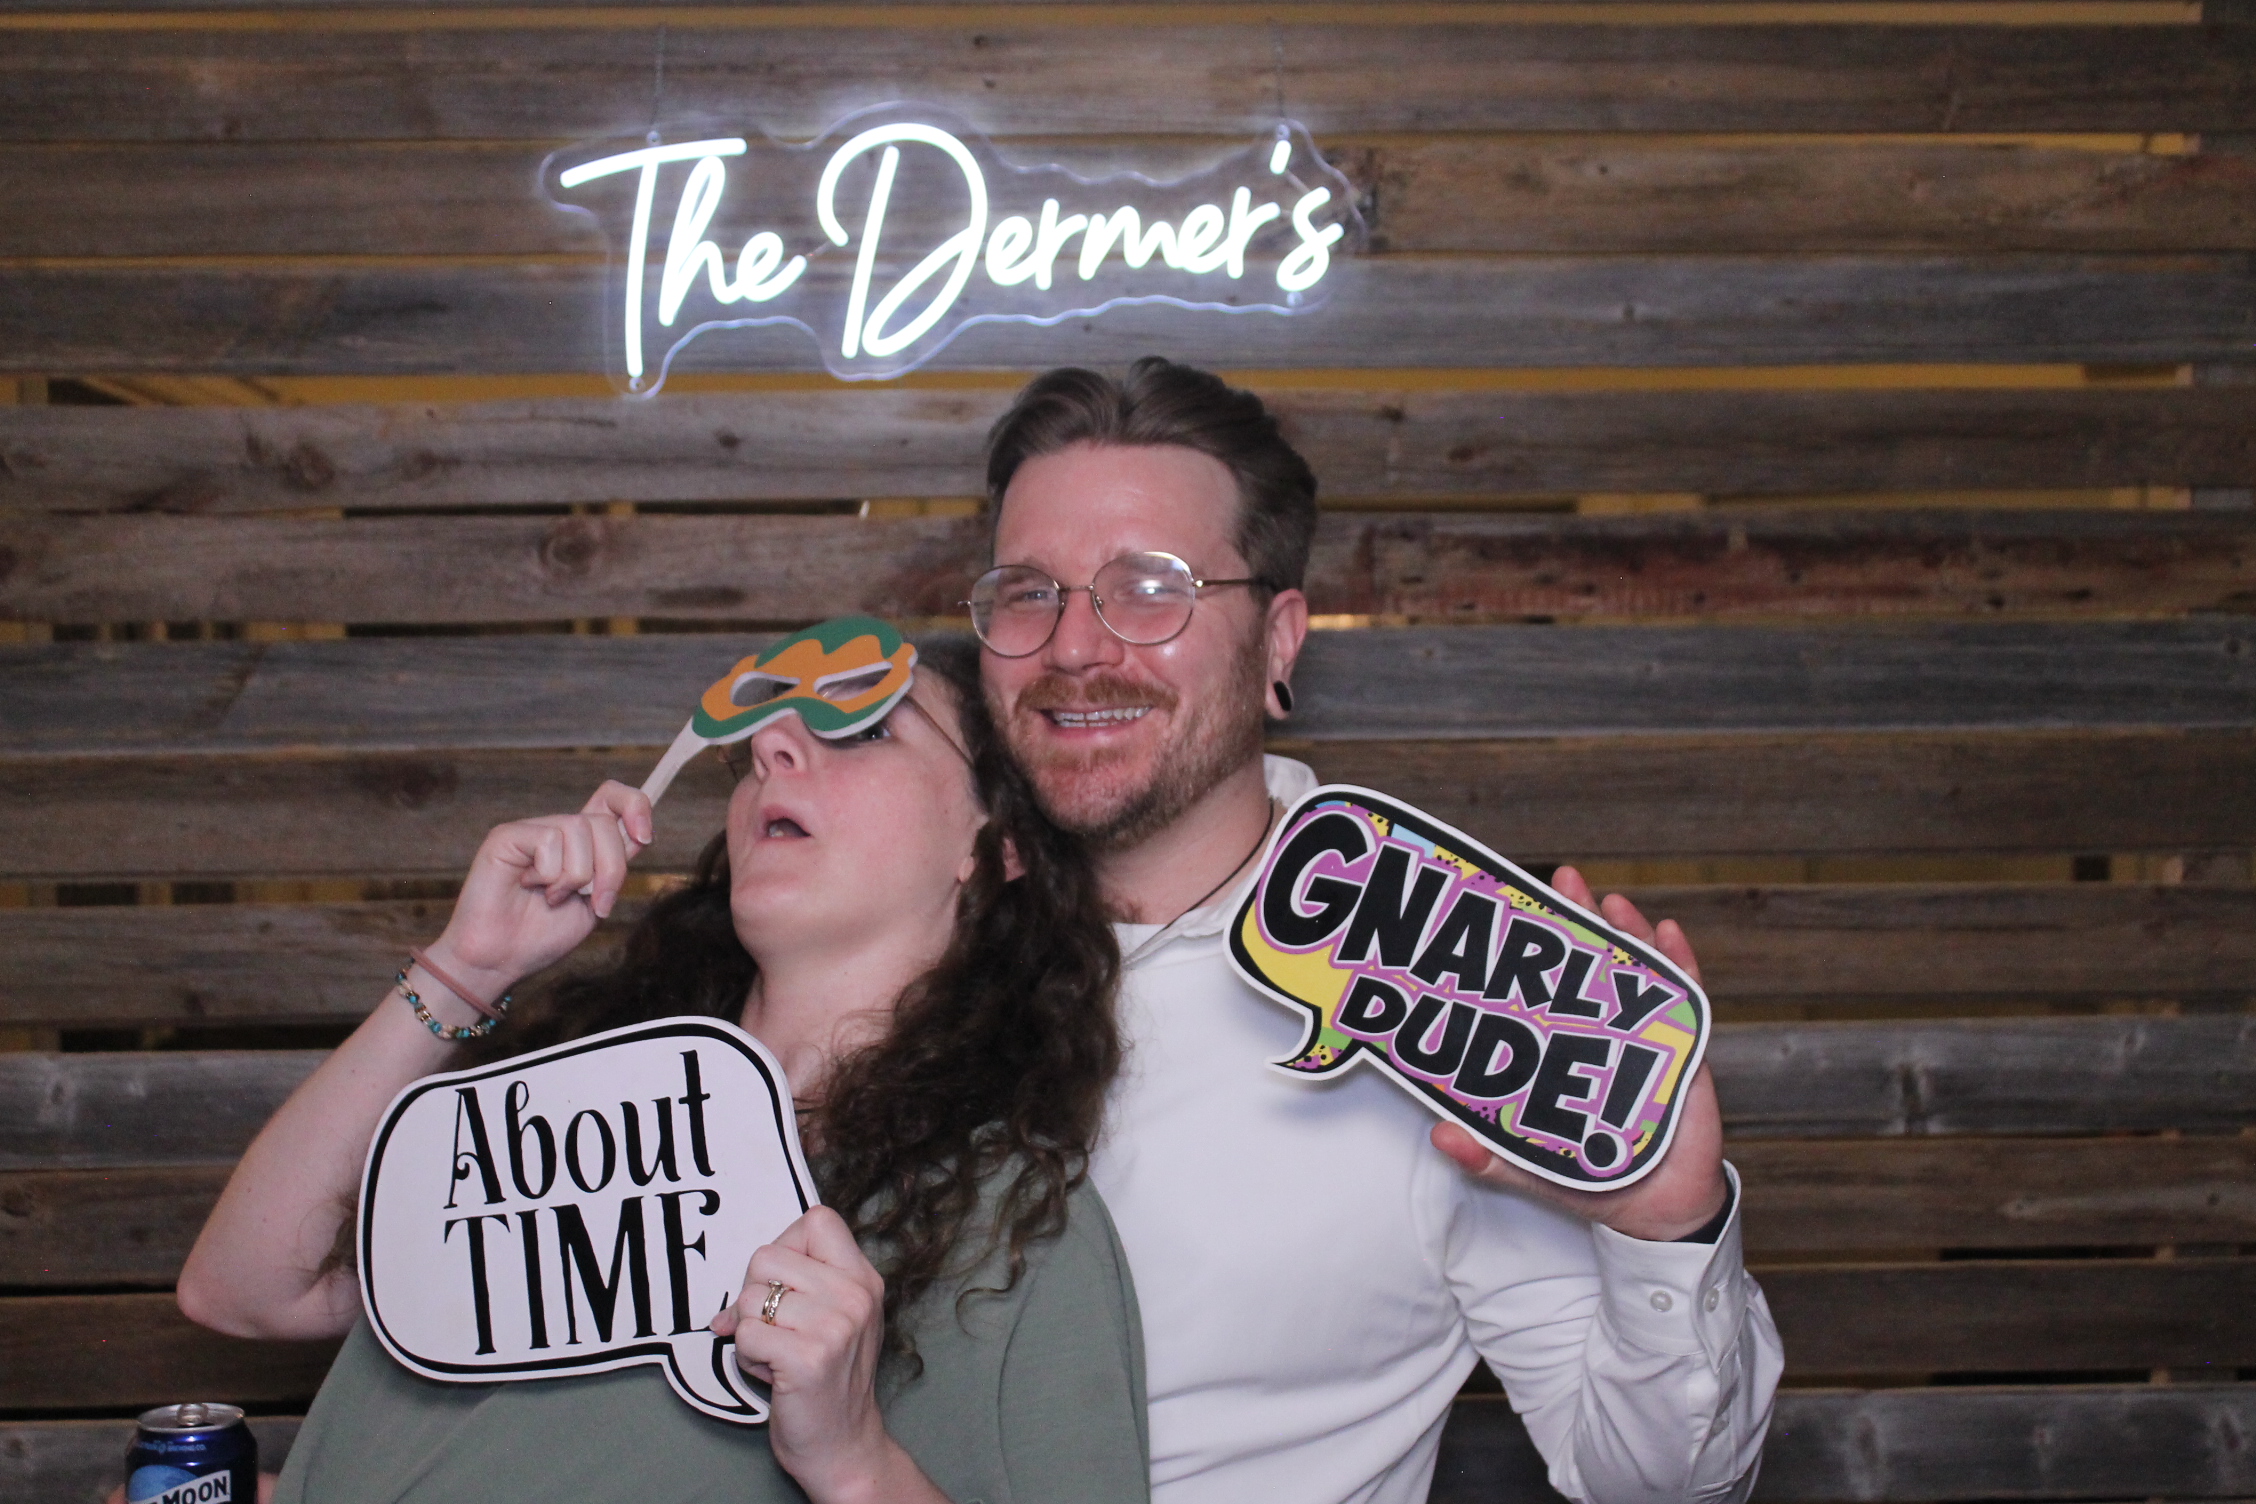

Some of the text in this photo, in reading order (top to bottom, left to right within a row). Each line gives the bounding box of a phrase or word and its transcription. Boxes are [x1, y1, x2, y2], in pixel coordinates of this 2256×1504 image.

[560, 122, 1344, 379] The Dermer's
[1261, 811, 1679, 1032] GNARLY
[443, 1049, 716, 1210] About
[1338, 974, 1664, 1169] DUDE!
[443, 1188, 730, 1356] TIME
[162, 1476, 227, 1504] MOON
